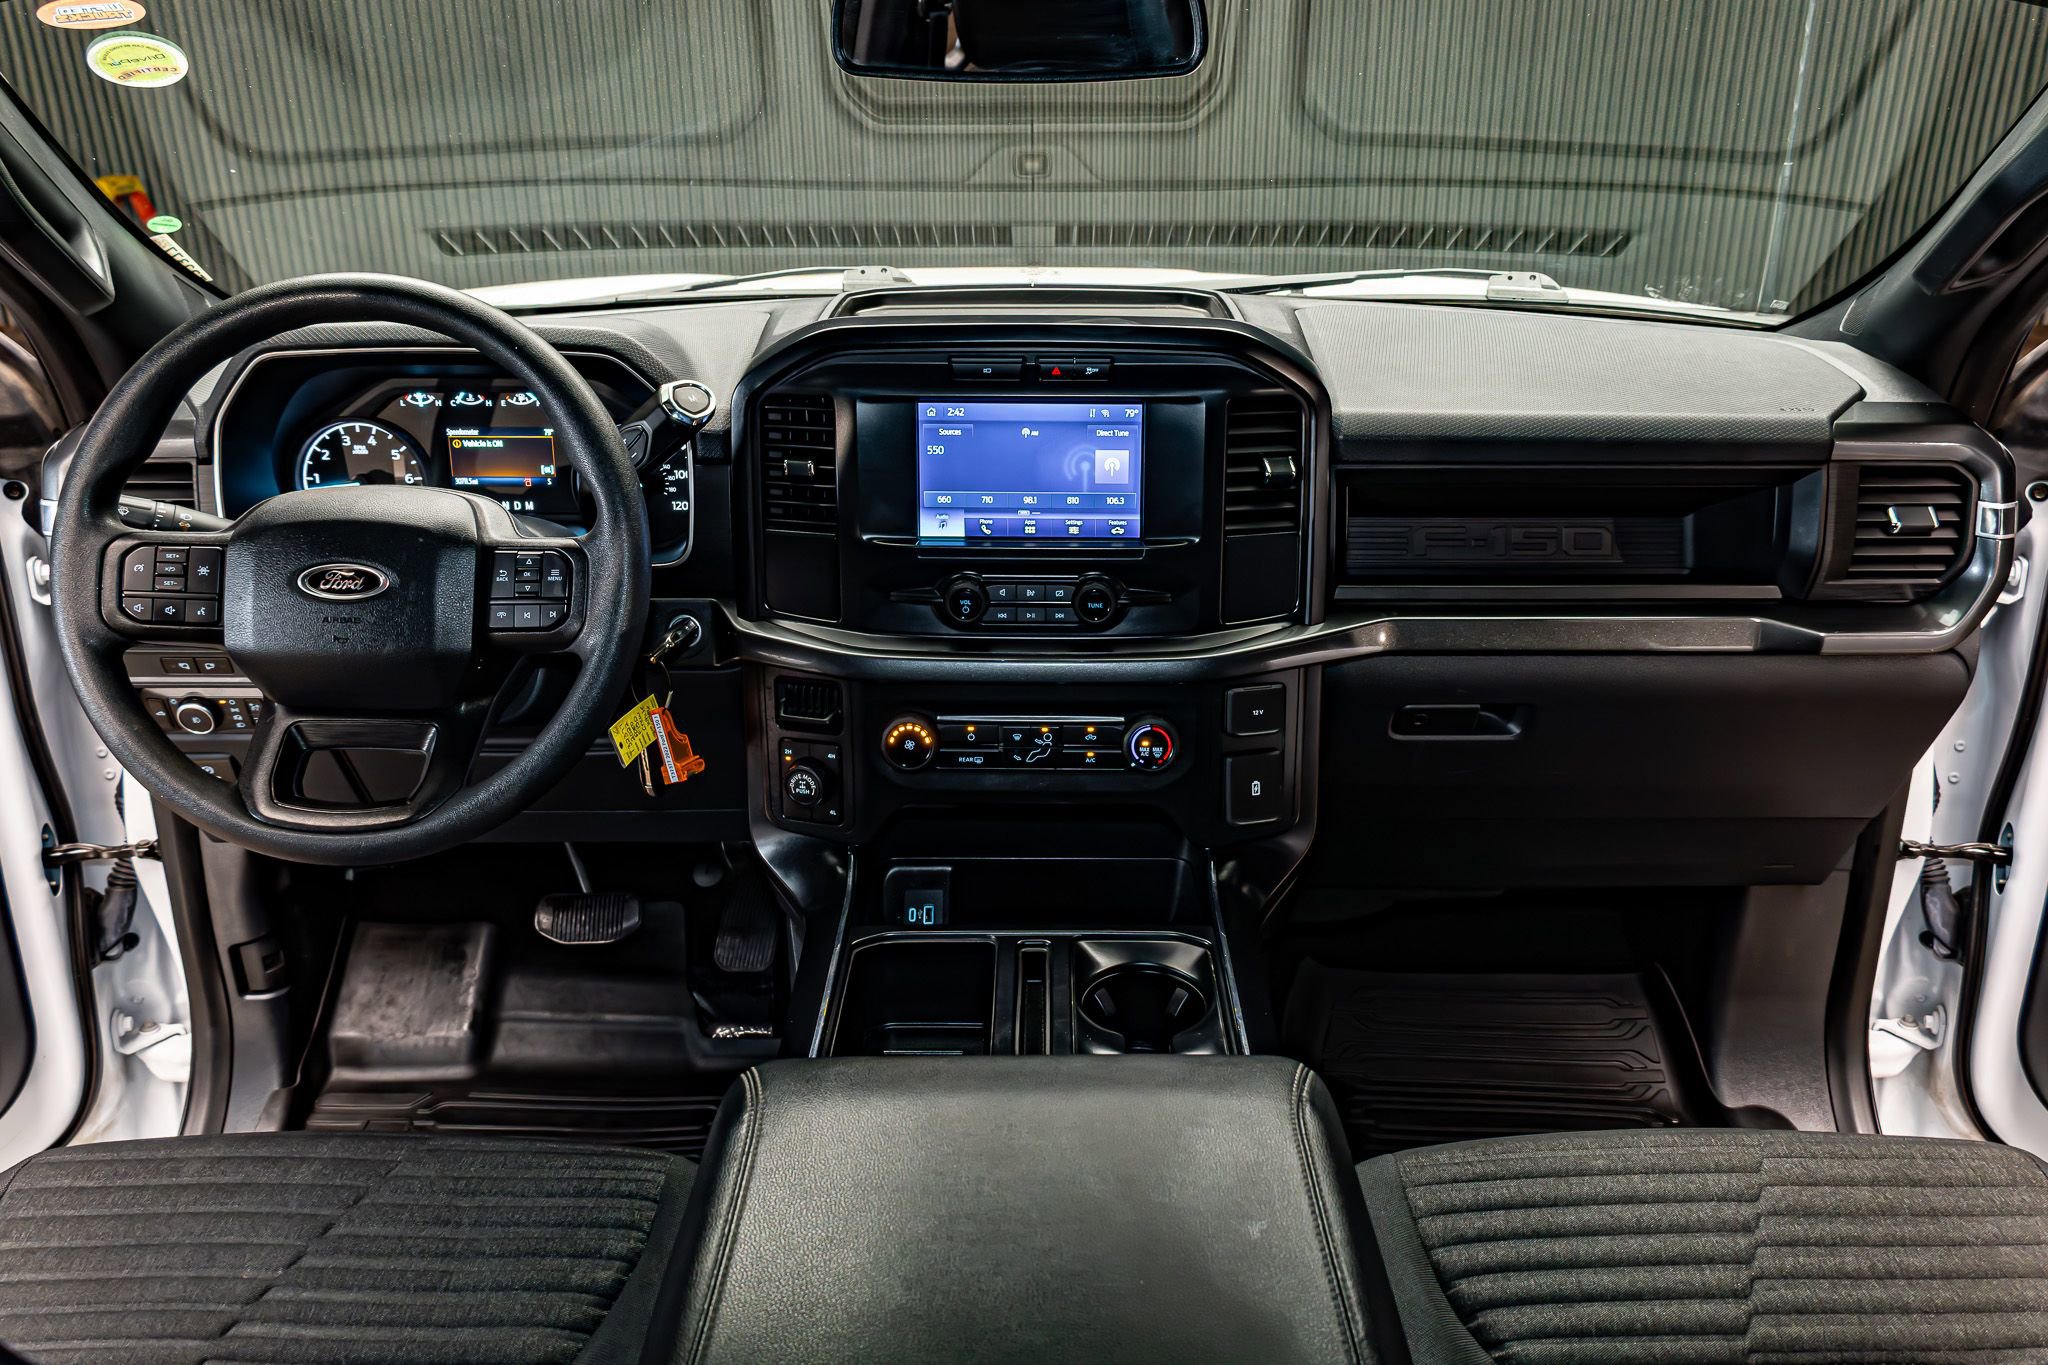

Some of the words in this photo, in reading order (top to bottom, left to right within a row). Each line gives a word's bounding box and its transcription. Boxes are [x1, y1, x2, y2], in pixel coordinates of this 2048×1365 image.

[434, 399, 442, 407] H
[450, 399, 457, 407] C
[485, 399, 493, 407] H
[500, 399, 507, 407] E
[947, 407, 965, 417] 2:42
[938, 428, 962, 436] Sources
[1096, 429, 1114, 437] Direct
[1115, 429, 1130, 437] Tune
[341, 435, 351, 446] 3
[367, 435, 377, 446] 4
[321, 449, 331, 460] 2
[391, 449, 400, 460] 5
[927, 445, 945, 455] 550
[313, 473, 320, 484] 1
[405, 473, 414, 484] 6
[937, 495, 952, 503] 660
[981, 495, 994, 504] 710
[1023, 496, 1038, 504] 98.1
[1066, 496, 1080, 505] 810
[1106, 497, 1125, 505] 106.3
[514, 501, 522, 511] D
[525, 501, 534, 511] M
[671, 501, 689, 510] 120
[1407, 526, 1614, 556] F-150
[319, 570, 366, 591] Ford
[655, 719, 663, 734] F-150
[790, 774, 802, 788] DRIVE
[802, 775, 816, 789] MODE
